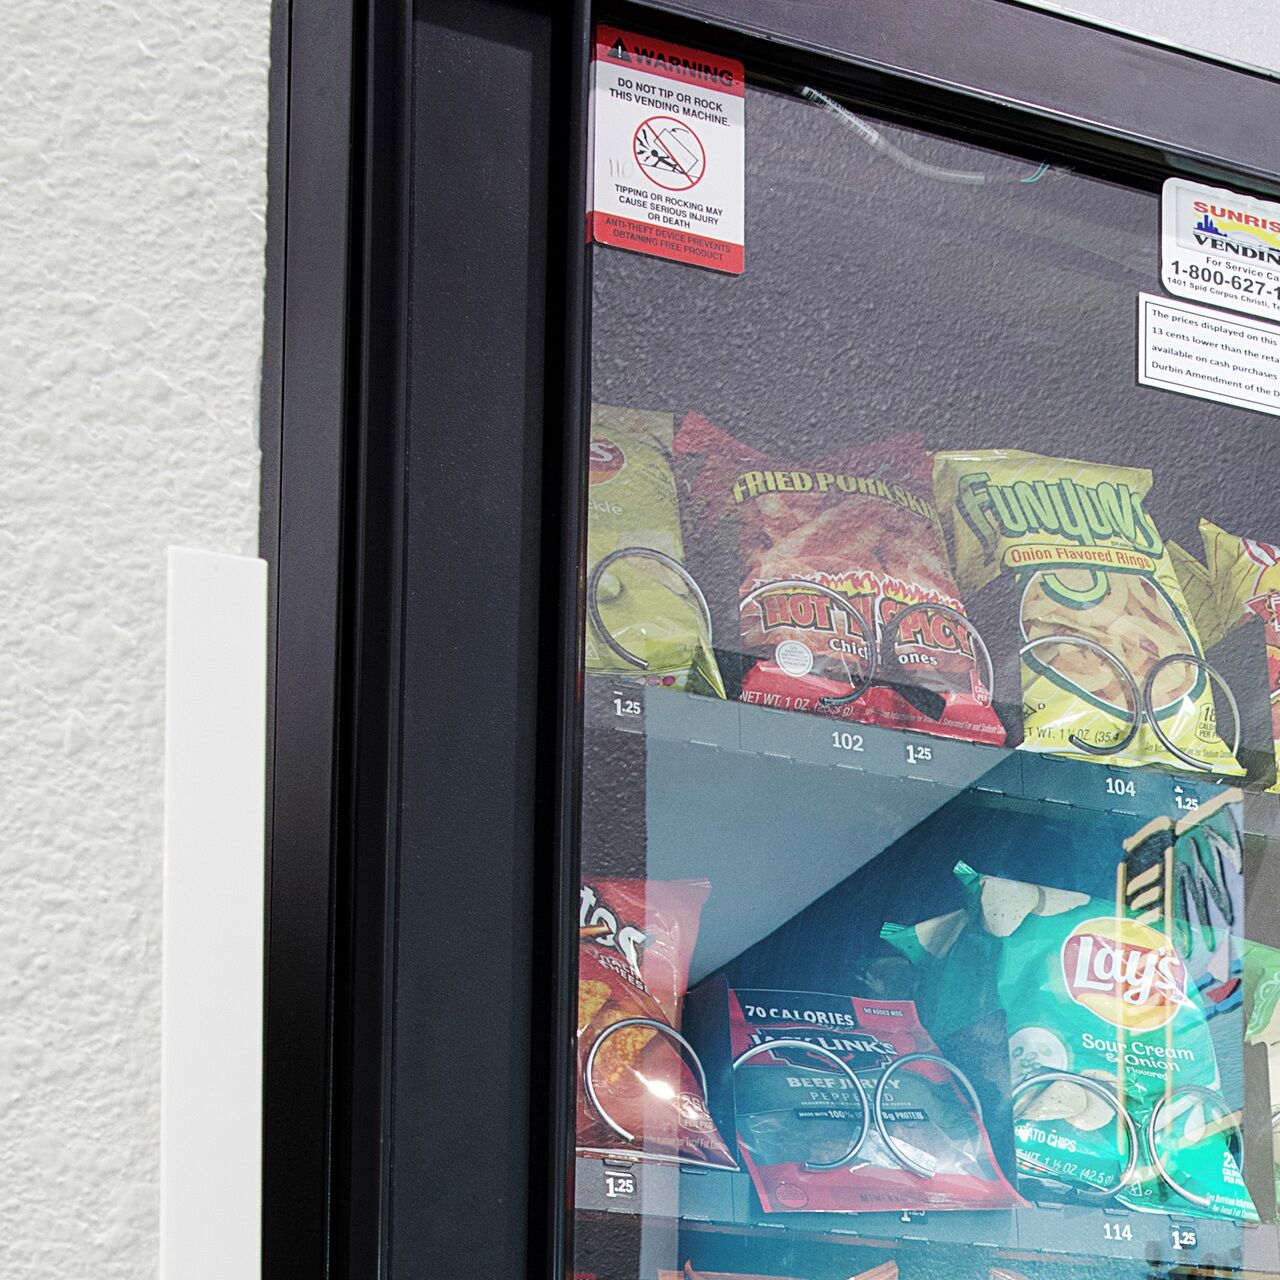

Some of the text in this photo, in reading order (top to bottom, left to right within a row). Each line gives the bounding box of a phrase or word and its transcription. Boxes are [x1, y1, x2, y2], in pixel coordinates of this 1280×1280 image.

[635, 47, 734, 87] WARNING
[609, 89, 730, 127] THIS VENDING MACHINE.
[618, 78, 722, 111] DO NOT TIP OR ROCK
[615, 184, 723, 216] TIPPING OR ROCKING MAY
[619, 196, 719, 225] CAUSE SERIOUS INJURY
[605, 218, 731, 252] ANTI-THEFT DEVICE PREVENTS
[648, 213, 690, 228] OR DEATH
[613, 230, 723, 260] OBTAINING FREE PRODUCT
[1206, 257, 1222, 266] For
[1226, 260, 1263, 278] Service
[1167, 276, 1187, 287] 1401
[1189, 282, 1207, 293] Spid
[1210, 287, 1238, 300] Corpus
[1241, 295, 1270, 309] Christi,
[1153, 309, 1169, 320] The
[1171, 314, 1198, 328] prices
[1201, 319, 1244, 341] displayed
[1246, 334, 1258, 342] on
[1261, 335, 1277, 346] this
[1152, 327, 1163, 335] 13
[1166, 331, 1190, 343] cents
[1192, 336, 1218, 349] lower
[1221, 342, 1242, 355] than
[1245, 349, 1259, 359] the
[1152, 344, 1193, 360] available
[1195, 353, 1207, 362] on
[1210, 356, 1230, 368] cash
[1232, 362, 1278, 380] purchases
[1152, 361, 1183, 376] Durbin
[1186, 369, 1242, 389] Amendment
[1245, 383, 1255, 392] of
[1256, 385, 1271, 396] the
[734, 471, 813, 502] FRIED
[1011, 548, 1150, 568] Onion Flavored Rings
[832, 732, 863, 751] 102
[1106, 778, 1135, 796] 104
[1074, 936, 1180, 1005] Lay's
[745, 1005, 854, 1026] 70 CALORIES
[1082, 1034, 1195, 1061] Sour Cream
[1125, 1054, 1181, 1072] Onion
[786, 1077, 834, 1088] BEEF
[1103, 1223, 1132, 1240] 114
